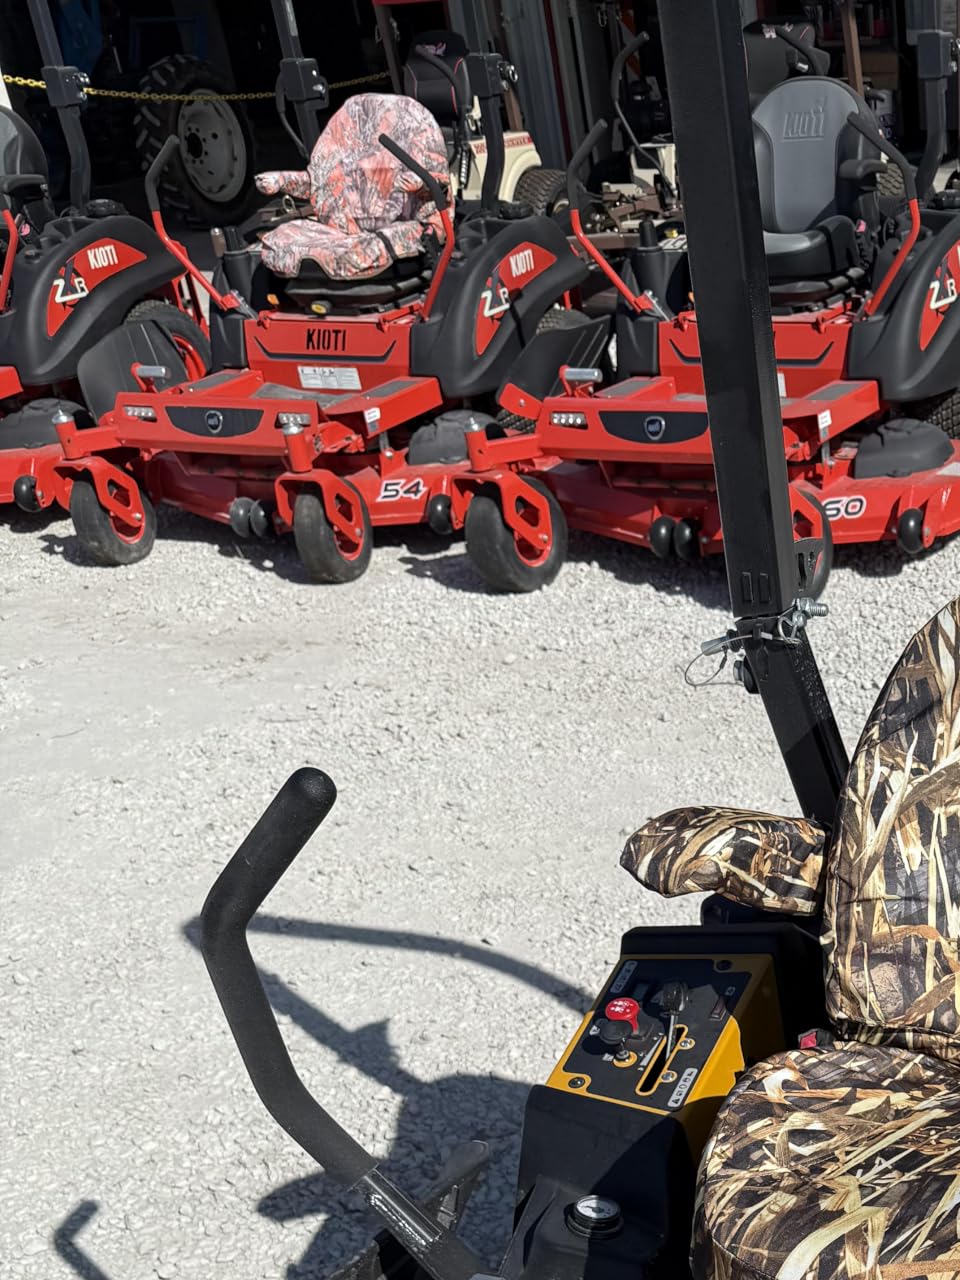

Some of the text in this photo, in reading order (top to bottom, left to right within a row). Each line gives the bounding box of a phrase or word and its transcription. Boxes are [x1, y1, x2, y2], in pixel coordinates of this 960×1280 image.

[87, 244, 119, 270] KIOTI
[509, 248, 535, 278] KIOTI
[306, 328, 347, 351] KIOTI
[379, 480, 424, 501] 54
[823, 496, 865, 519] 60
